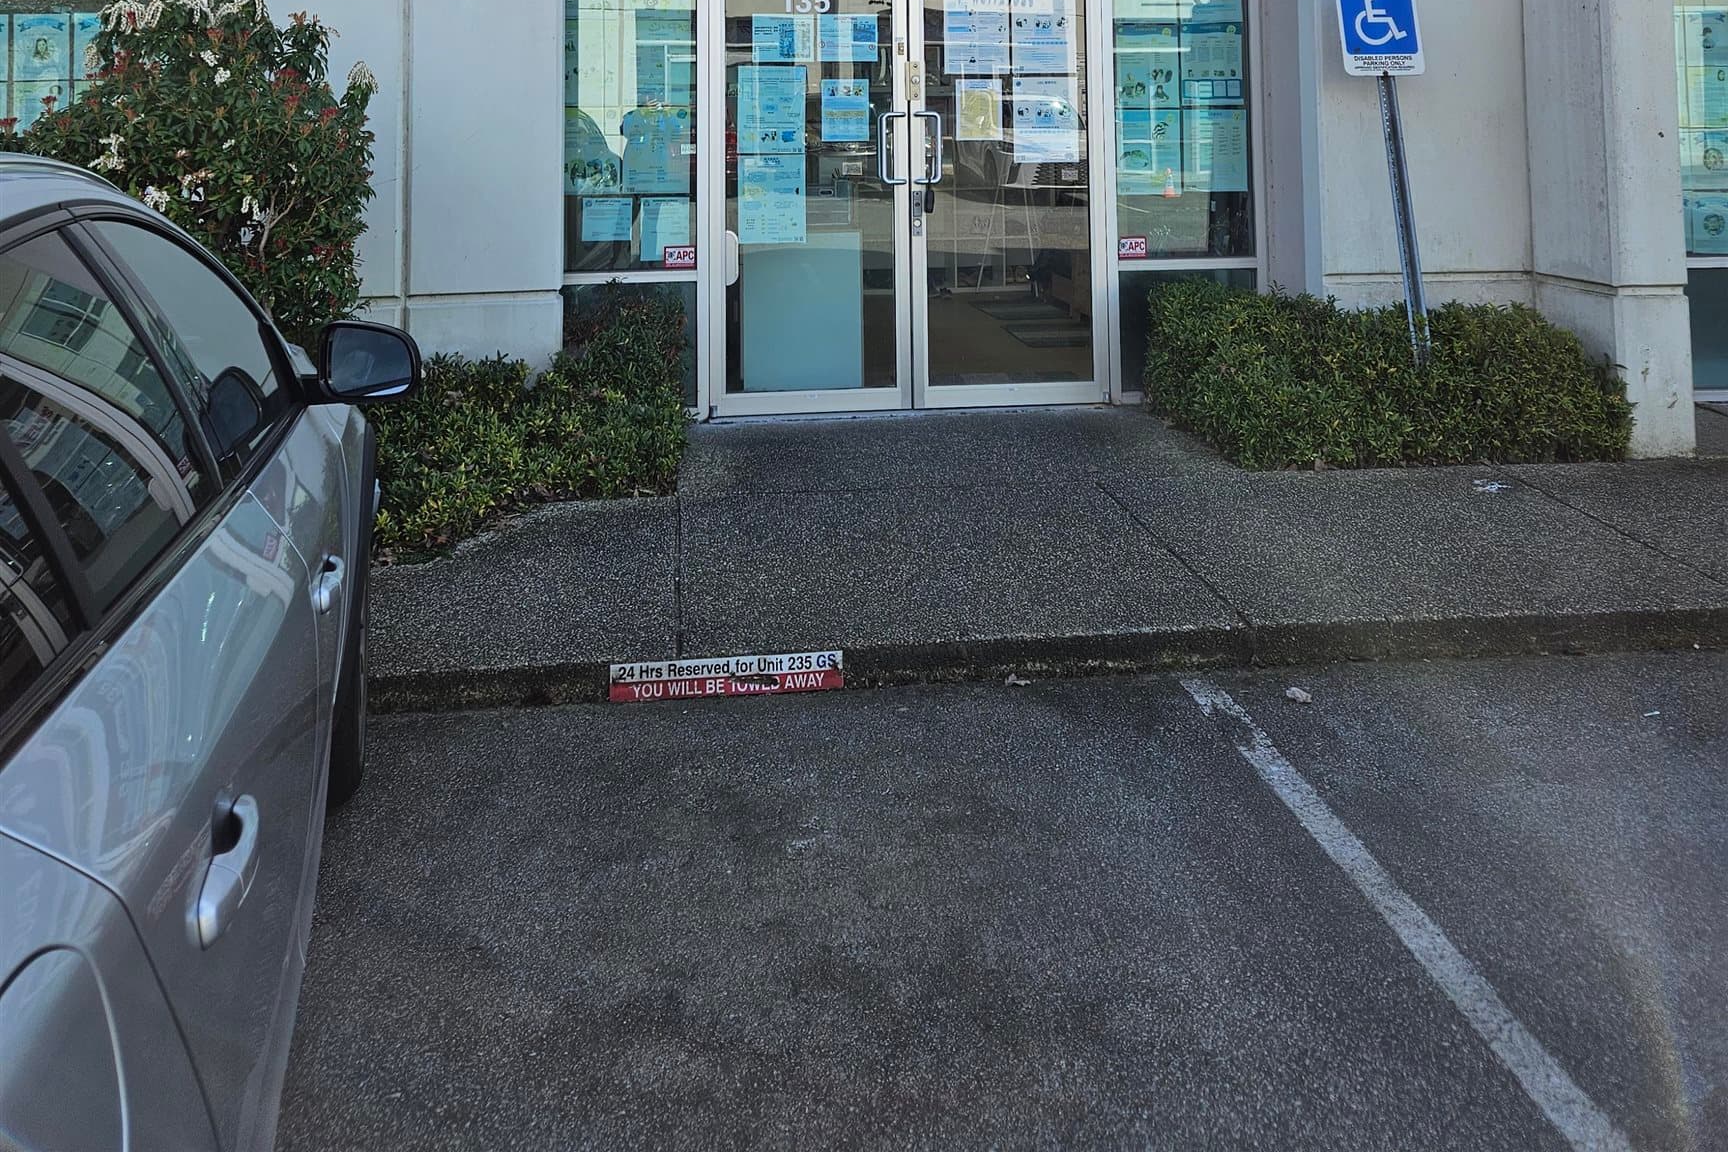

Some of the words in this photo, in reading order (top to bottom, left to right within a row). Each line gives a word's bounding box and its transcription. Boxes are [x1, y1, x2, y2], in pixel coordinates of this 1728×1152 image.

[1129, 241, 1145, 251] APC
[676, 250, 694, 261] APC
[618, 666, 635, 680] 24
[639, 665, 663, 679] Hrs
[668, 660, 730, 677] Reserved
[736, 658, 753, 673] for
[758, 657, 783, 672] Unit
[788, 655, 812, 670] 235
[631, 683, 663, 698] YOU
[667, 680, 702, 695] WILL
[706, 678, 725, 693] BE
[784, 672, 825, 689] AWAY
